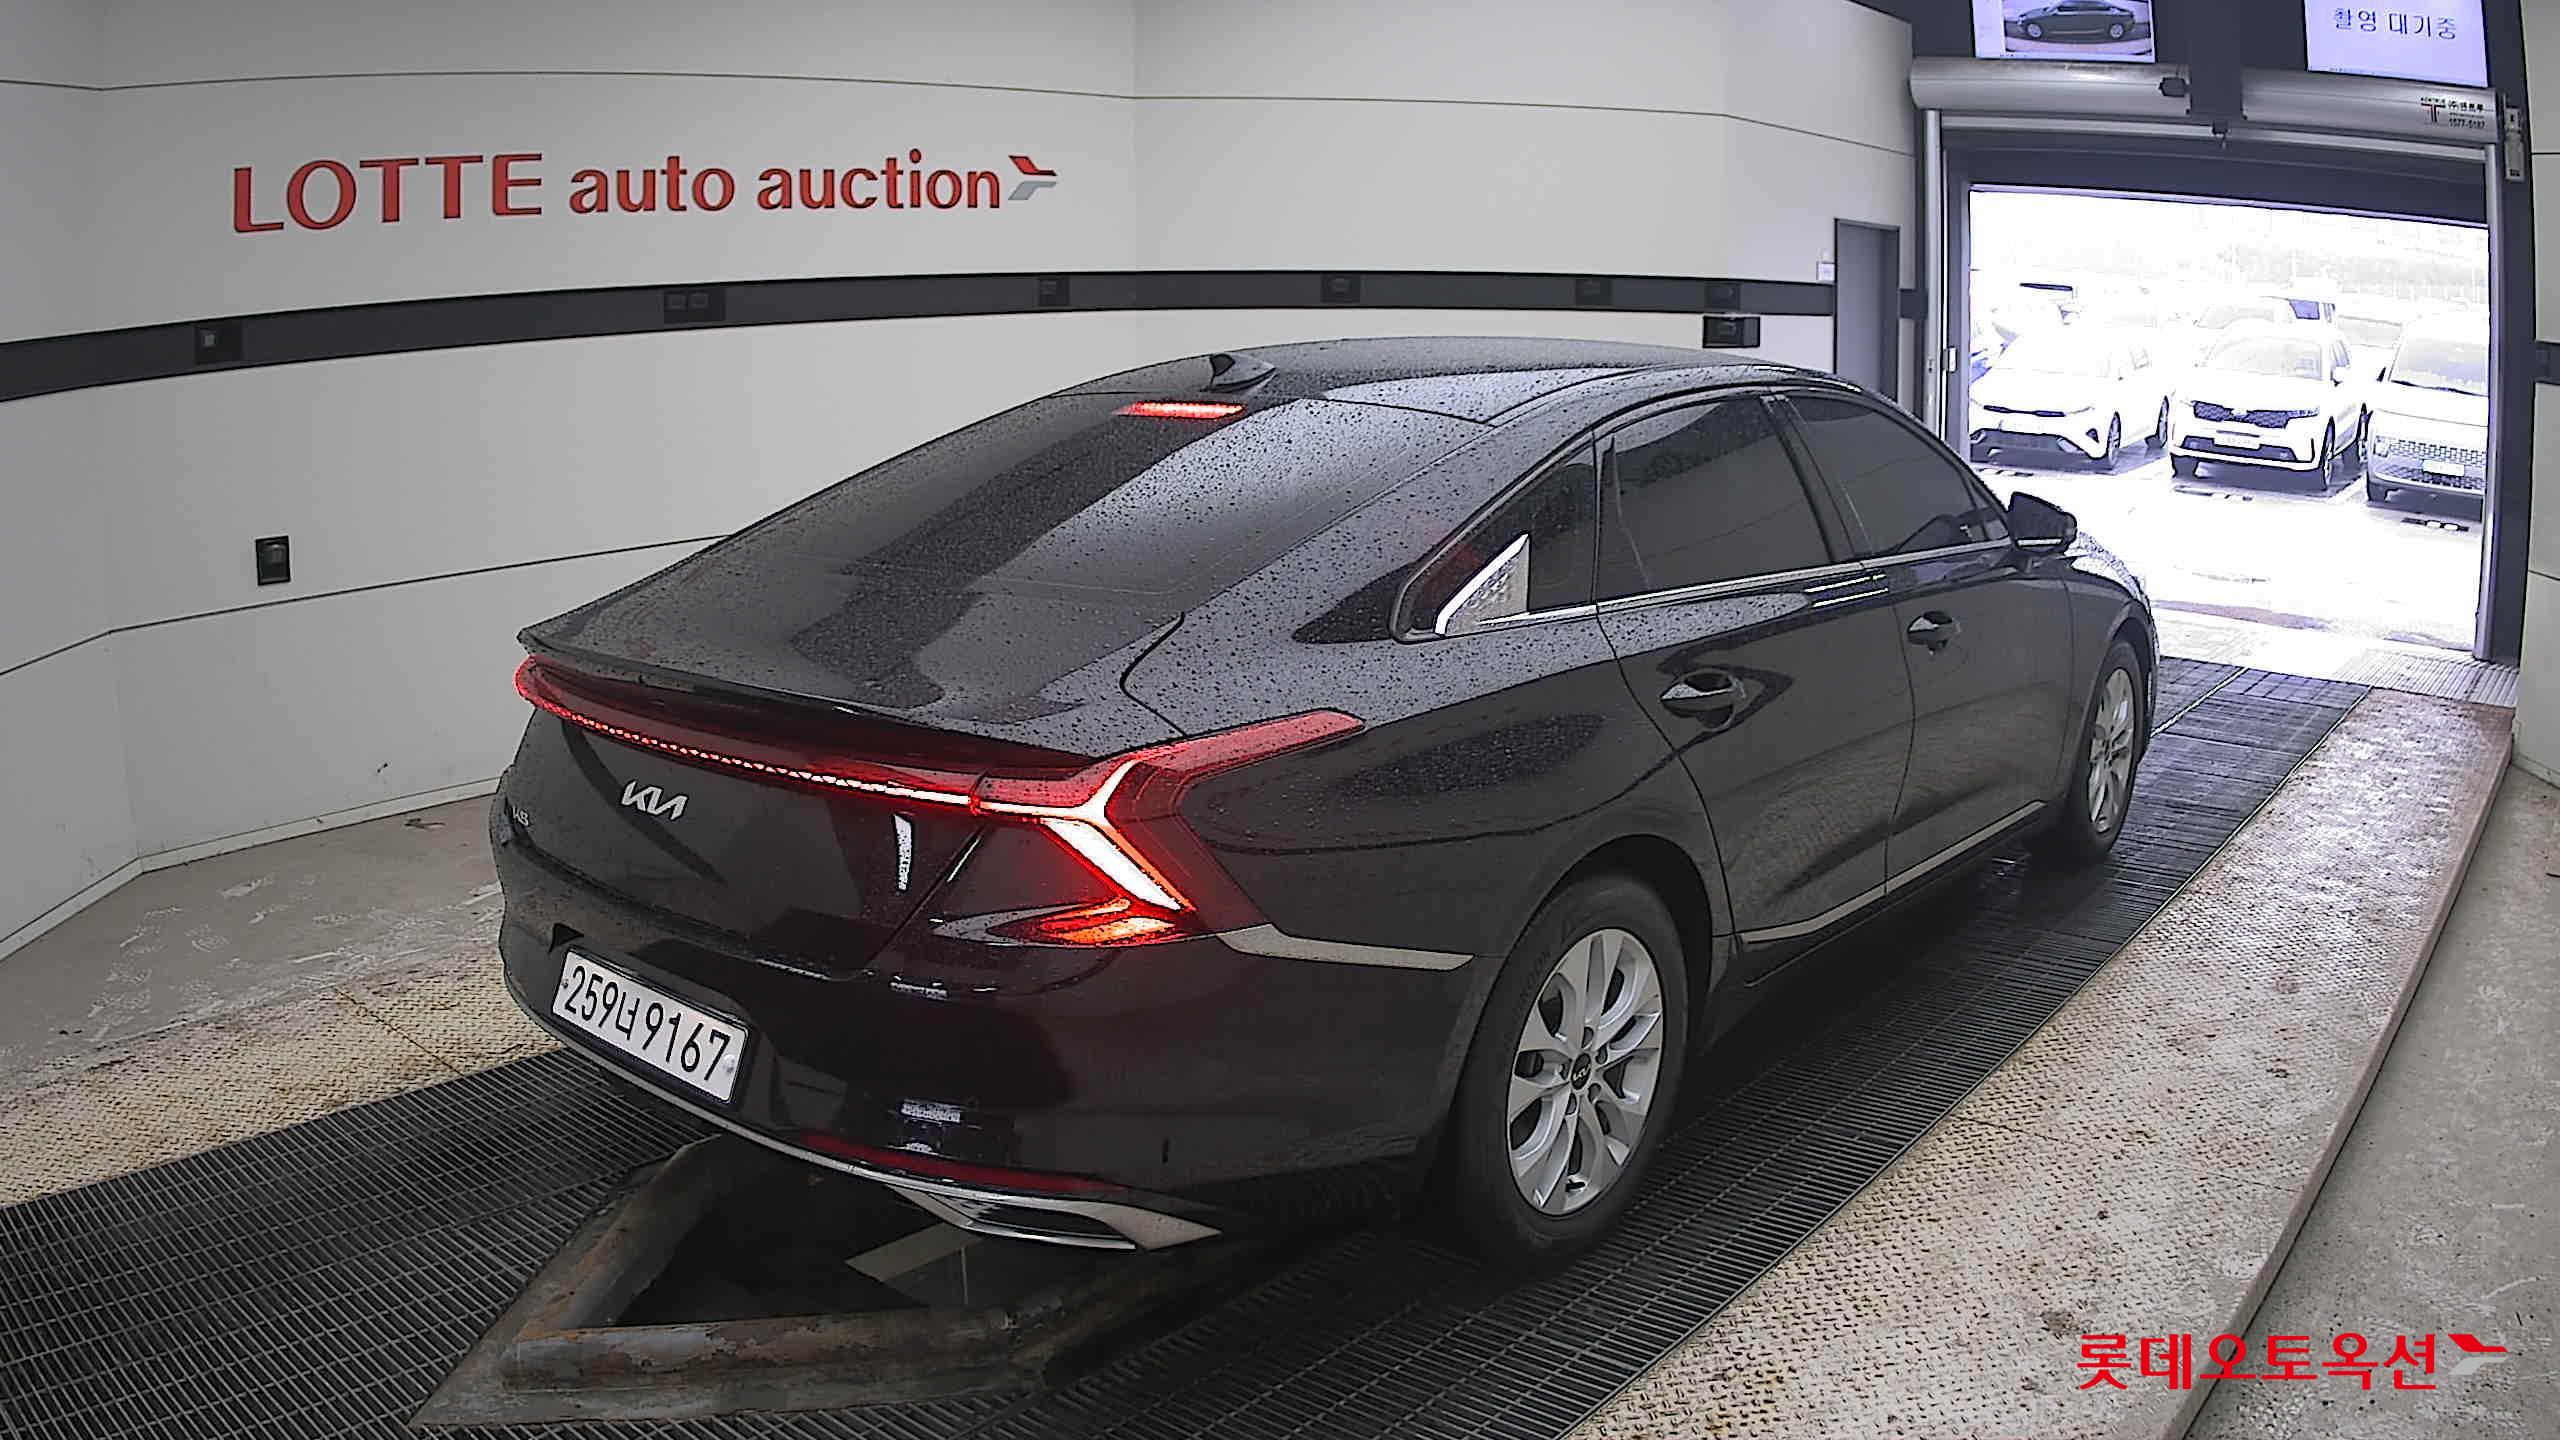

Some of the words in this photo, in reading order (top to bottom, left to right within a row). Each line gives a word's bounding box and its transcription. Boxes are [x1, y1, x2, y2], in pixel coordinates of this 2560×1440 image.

[233, 153, 543, 234] LOTTE
[568, 155, 737, 214] auto
[756, 148, 1001, 210] auction
[621, 779, 689, 821] KIA
